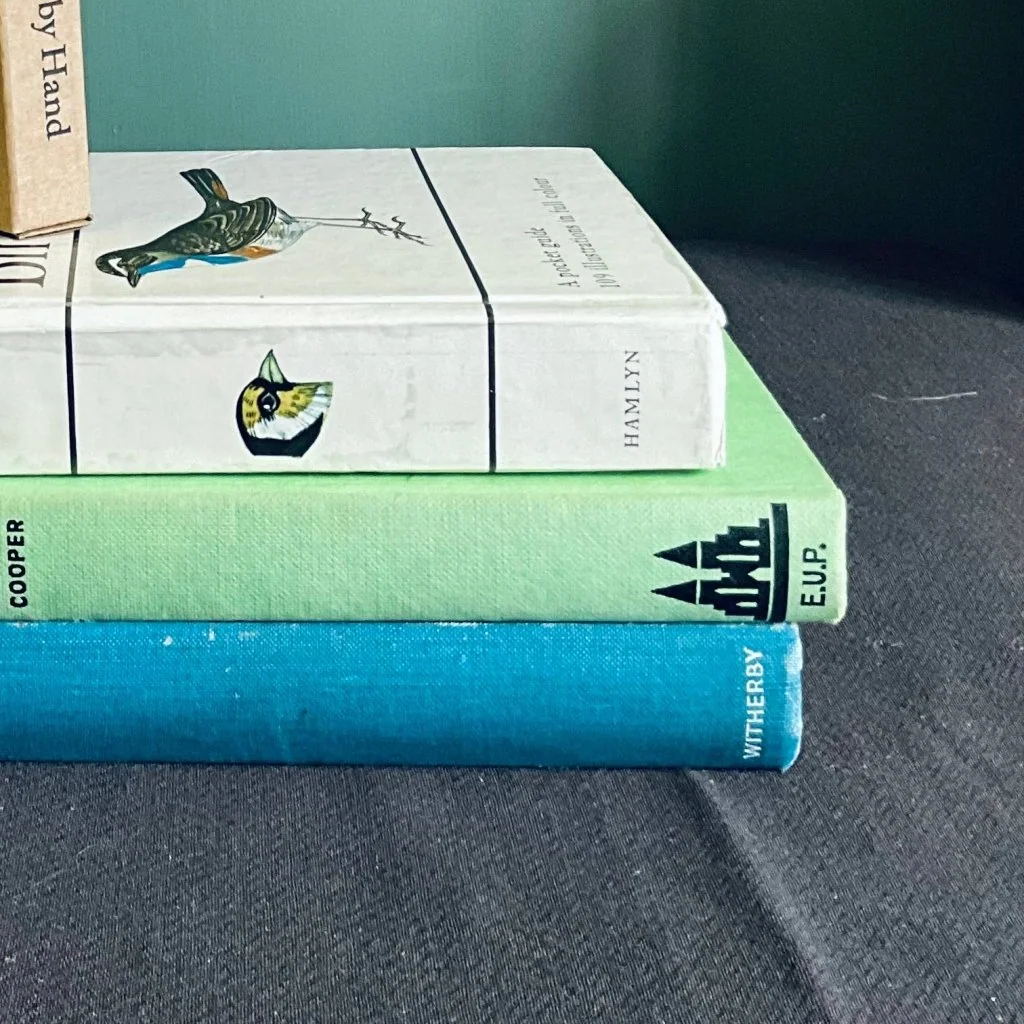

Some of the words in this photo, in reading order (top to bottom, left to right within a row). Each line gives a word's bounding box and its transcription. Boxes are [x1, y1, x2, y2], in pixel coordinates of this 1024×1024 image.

[40, 43, 72, 140] Hand
[532, 177, 559, 199] colour
[541, 201, 570, 213] full
[556, 215, 576, 223] in
[523, 227, 561, 248] guide
[566, 224, 609, 271] illustrations
[541, 250, 580, 278] pocket
[557, 280, 581, 288] A
[592, 273, 621, 288] 109
[624, 349, 641, 448] HAMLYN
[6, 518, 29, 609] COOPER
[800, 542, 828, 607] E.U.P.
[742, 645, 766, 761] WITHERBY
